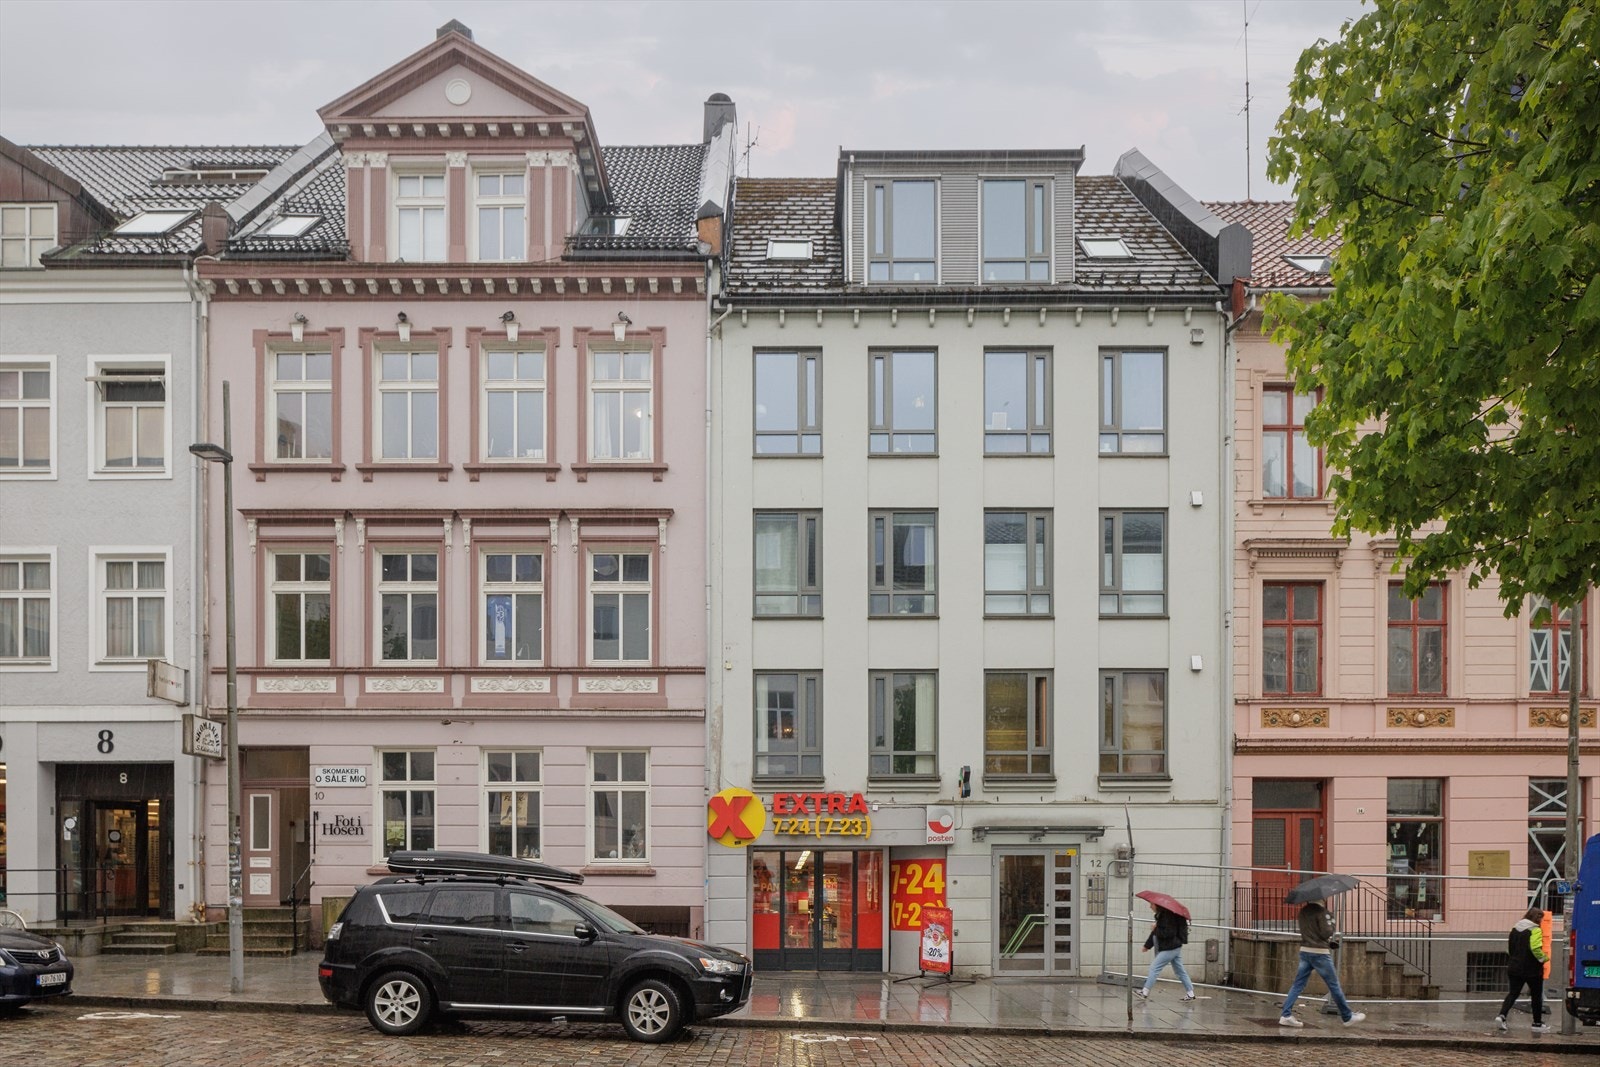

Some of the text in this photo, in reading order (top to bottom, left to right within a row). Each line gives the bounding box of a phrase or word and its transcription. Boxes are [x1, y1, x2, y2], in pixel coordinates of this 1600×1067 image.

[97, 729, 115, 754] 8
[119, 772, 128, 784] 8
[315, 774, 366, 783] O SÅLE MIO
[314, 791, 325, 801] 10
[772, 792, 869, 815] EXTRA
[335, 815, 362, 827] Fot i
[322, 823, 364, 836] Hosen
[772, 815, 872, 840] 7-24 (7-23)
[927, 834, 954, 844] posten
[1090, 859, 1102, 868] 12
[891, 863, 946, 895] 7-24
